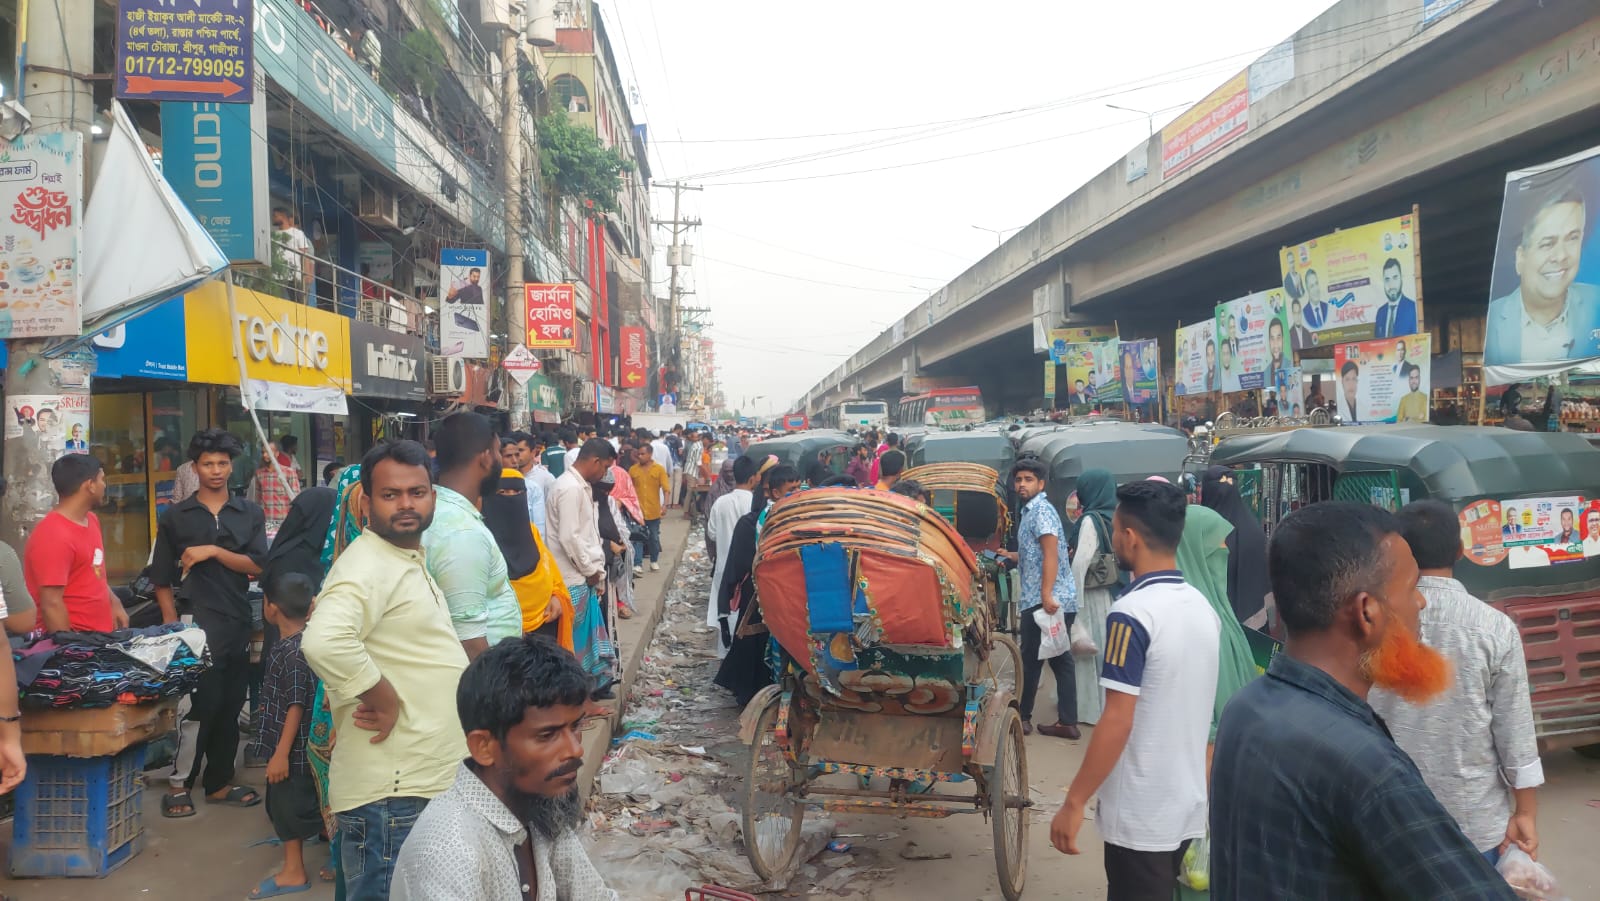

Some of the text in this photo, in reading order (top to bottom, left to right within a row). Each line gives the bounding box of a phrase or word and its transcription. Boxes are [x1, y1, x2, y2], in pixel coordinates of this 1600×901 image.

[127, 8, 144, 22] হাজী
[176, 10, 195, 23] আলী
[198, 11, 223, 24] মার্কেট
[224, 14, 245, 26] নং-২
[171, 28, 193, 38] রাস্তার
[196, 26, 218, 38] পশ্চিম
[183, 40, 206, 56] শ্রীপুর,
[209, 41, 238, 57] গাজীপুর
[125, 56, 245, 77] 01712-799095
[14, 162, 32, 175] ফার্ম
[17, 186, 68, 209] শুভ
[530, 285, 571, 303] জার্মান
[529, 305, 572, 323] হোমিও
[540, 324, 562, 338] হল
[232, 312, 329, 370] realme
[367, 342, 418, 383] Infinix
